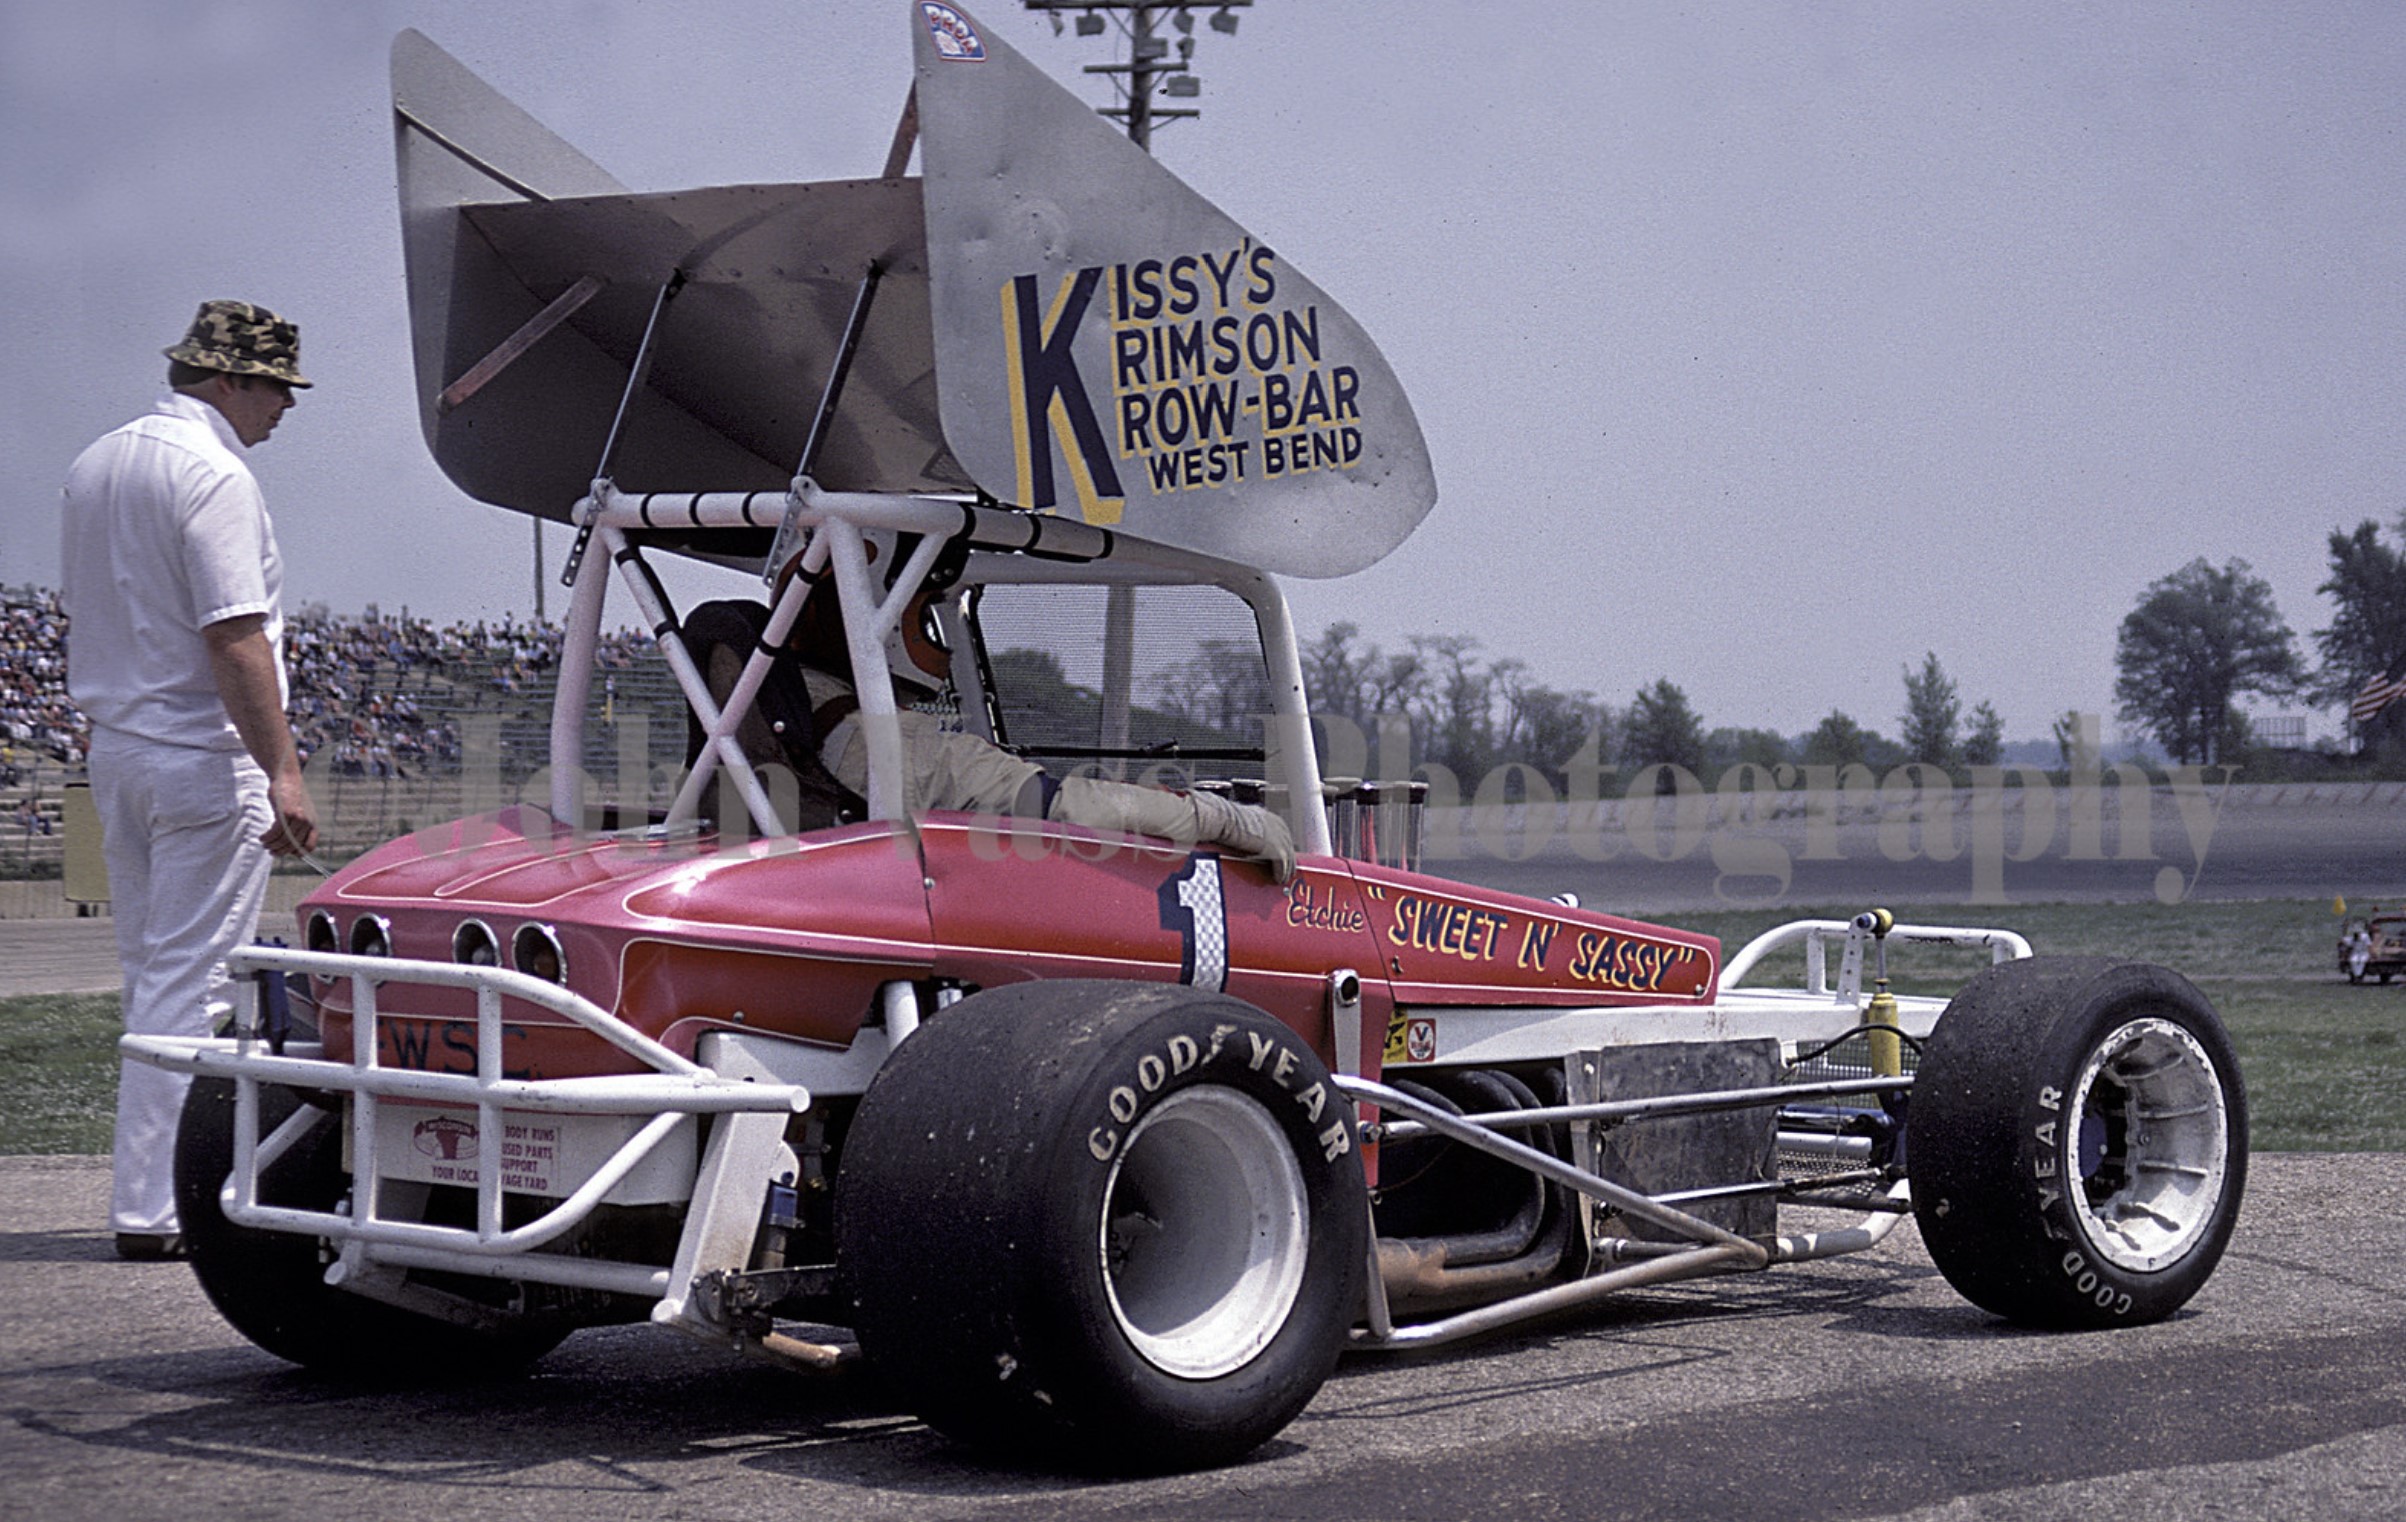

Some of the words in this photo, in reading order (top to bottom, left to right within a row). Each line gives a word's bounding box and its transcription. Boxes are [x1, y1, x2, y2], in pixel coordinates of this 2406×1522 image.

[1113, 305, 1323, 395] RIMSON
[1119, 365, 1363, 459] ROW-BAR
[1147, 441, 1250, 495] WEST
[1261, 427, 1364, 481] BEND
[1157, 850, 1229, 992] 1
[526, 1145, 553, 1159] PARTS
